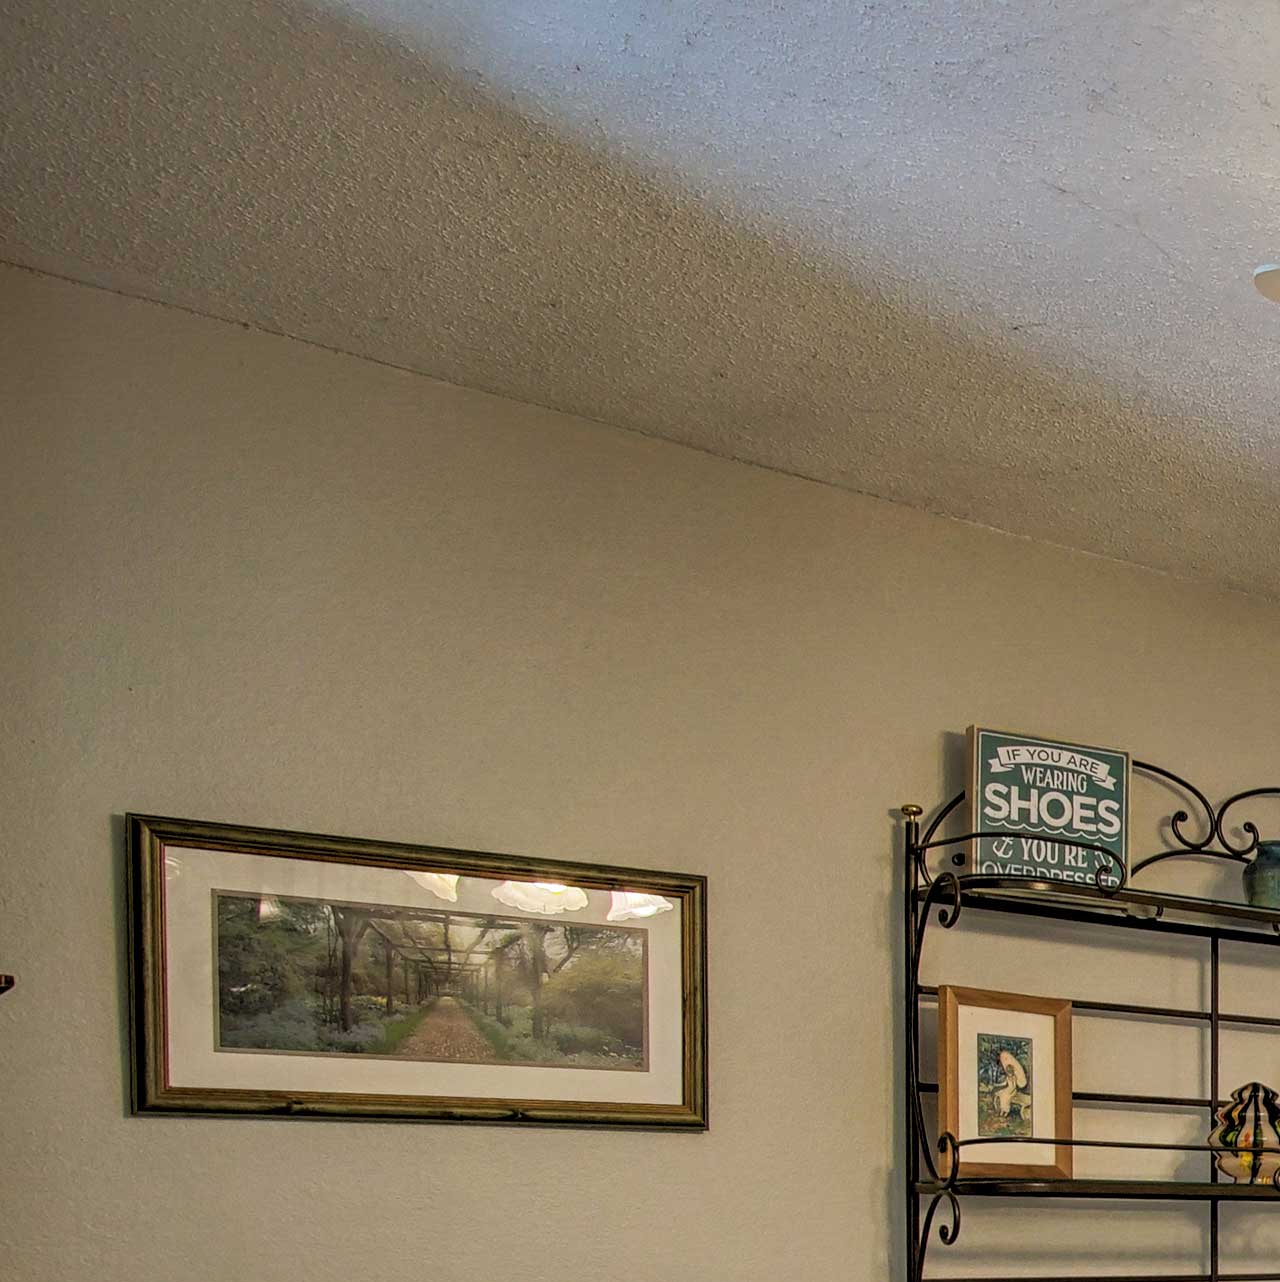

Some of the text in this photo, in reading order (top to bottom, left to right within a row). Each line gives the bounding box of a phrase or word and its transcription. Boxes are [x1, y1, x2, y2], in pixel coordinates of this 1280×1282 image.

[1006, 748, 1100, 774] IF YOU ARE
[1021, 765, 1087, 793] WEARING
[983, 782, 1121, 835] SHOES
[1021, 837, 1088, 867] YOURE
